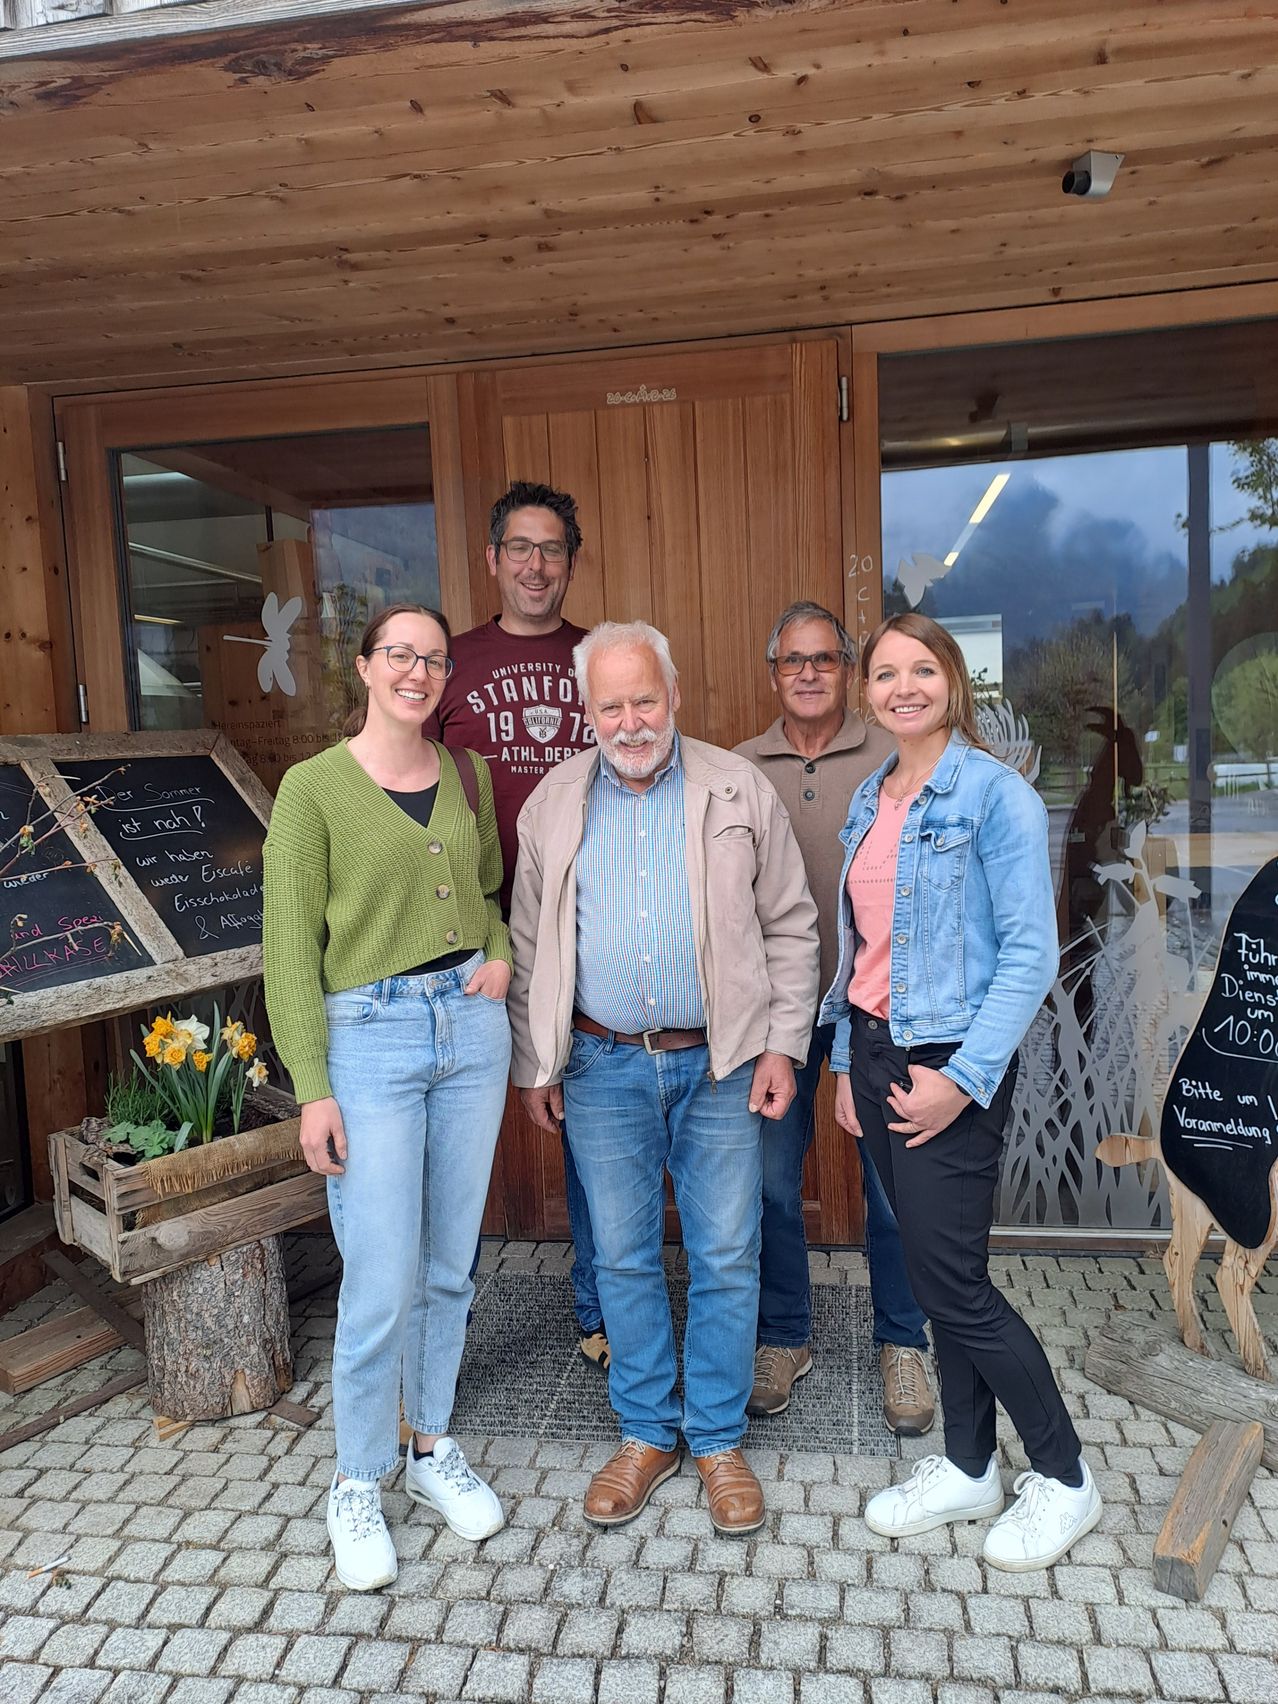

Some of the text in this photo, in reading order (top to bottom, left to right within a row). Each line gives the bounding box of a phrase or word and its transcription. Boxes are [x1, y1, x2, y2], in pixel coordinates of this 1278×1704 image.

[848, 554, 873, 577] 20
[857, 586, 870, 601] C
[492, 662, 576, 680] UNIVERSITY O
[487, 711, 514, 743] 19
[511, 765, 544, 775] MASTER
[95, 783, 201, 803] Der Sommer
[118, 818, 142, 834] ist
[136, 849, 214, 867] wir haben
[195, 916, 220, 940] &
[1233, 933, 1278, 966] Führ
[1247, 1007, 1274, 1023] um
[1179, 1078, 1258, 1107] Bitte um
[1173, 1104, 1272, 1145] Voranmeldung
